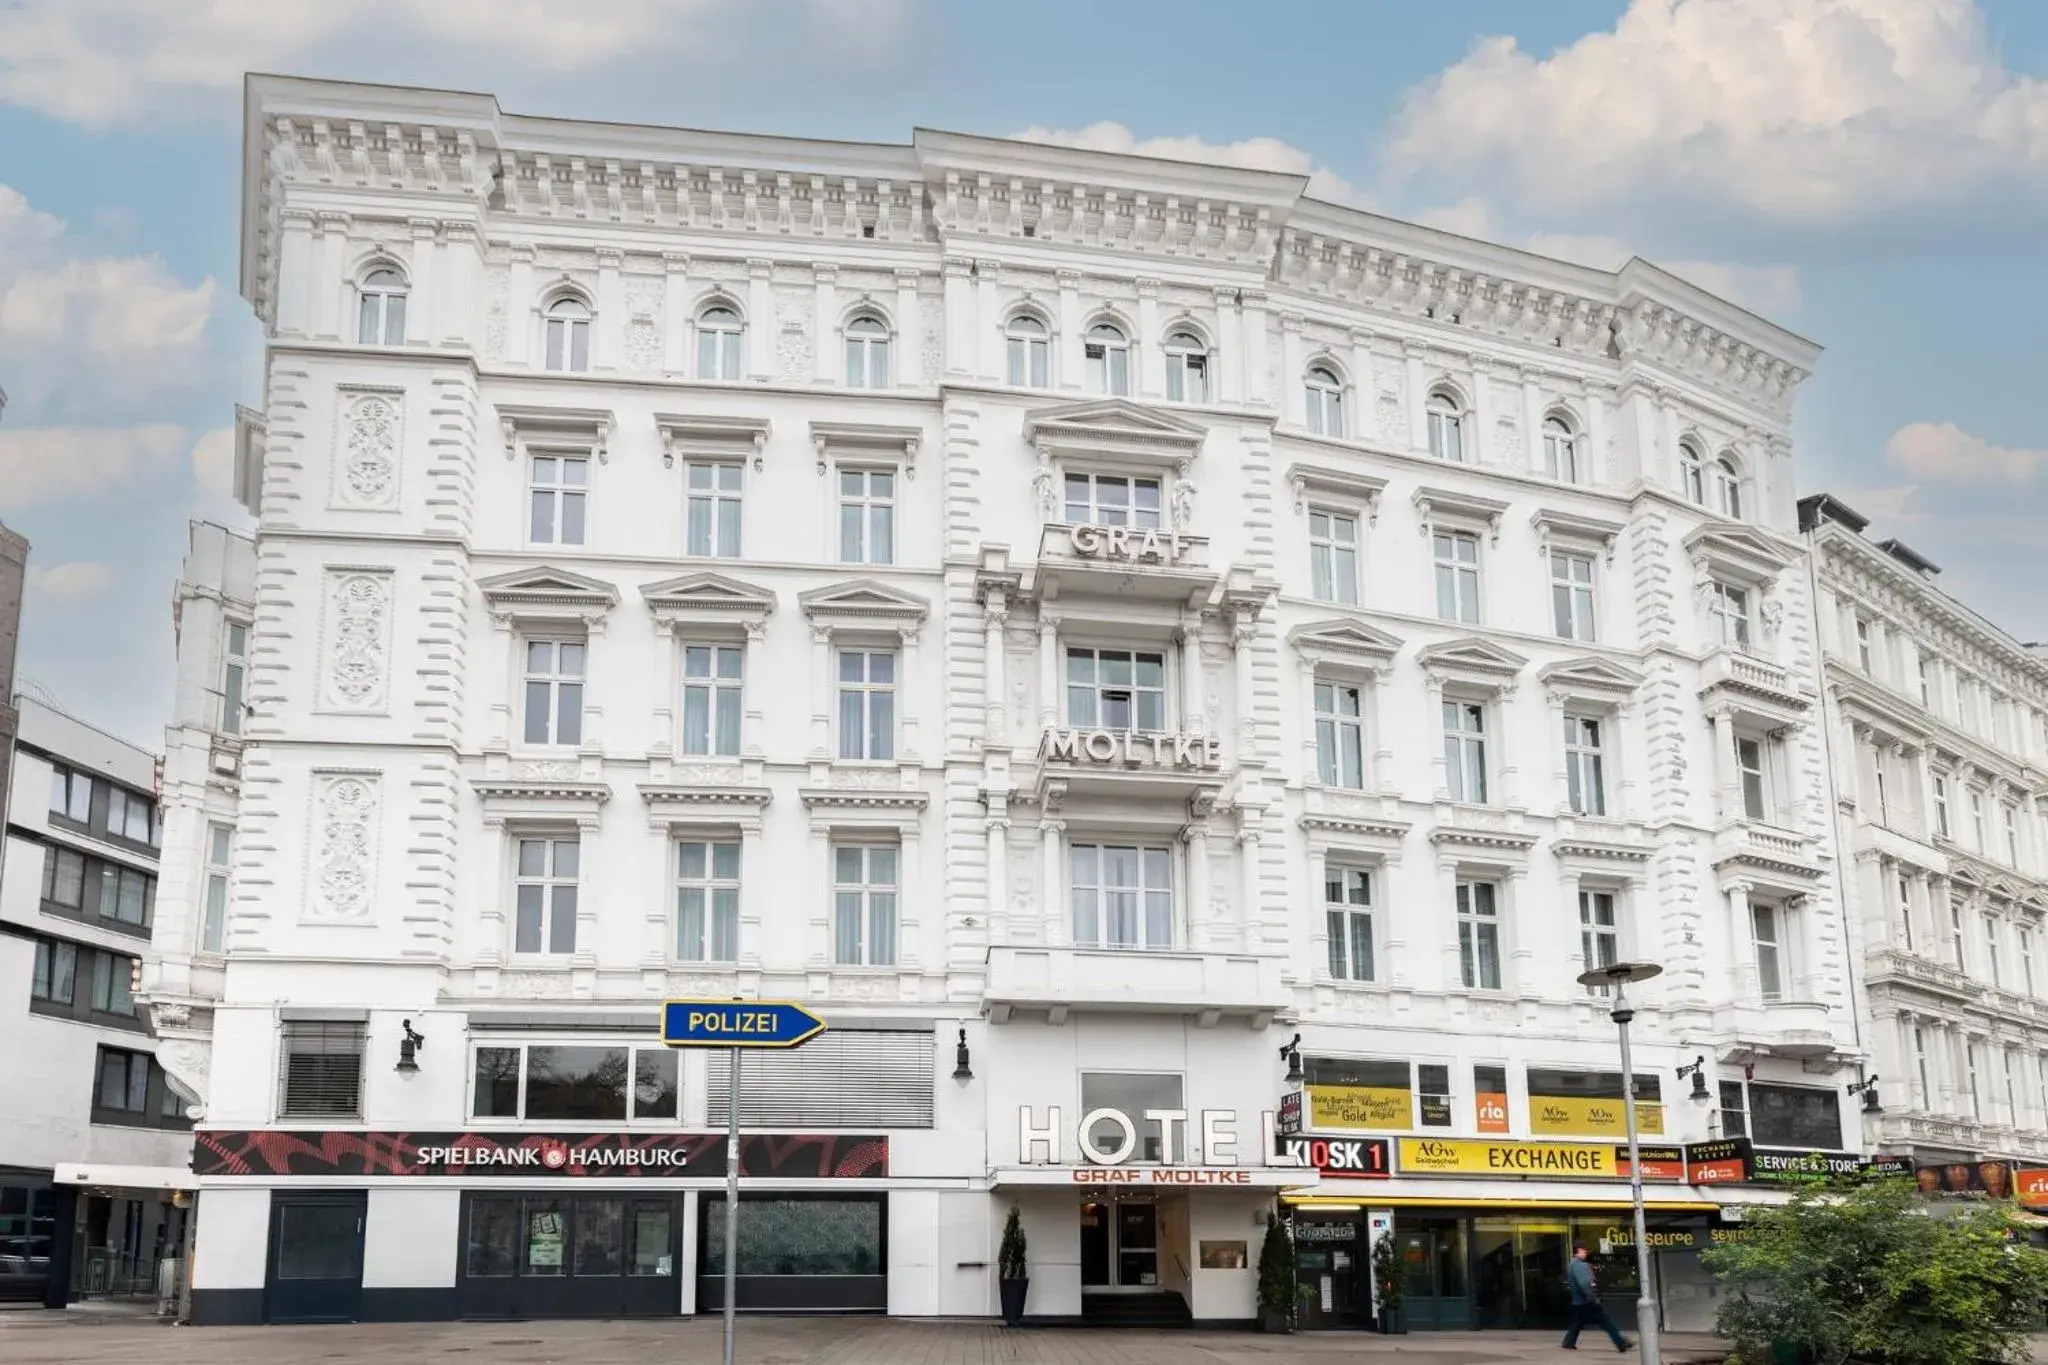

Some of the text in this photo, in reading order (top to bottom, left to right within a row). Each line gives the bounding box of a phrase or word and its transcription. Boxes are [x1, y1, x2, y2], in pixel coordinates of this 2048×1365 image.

[1071, 524, 1189, 565] GRAF
[1044, 726, 1221, 768] MOLTKE
[689, 1012, 778, 1034] POLIZEI
[1283, 1094, 1300, 1107] LATE
[1480, 1101, 1504, 1119] ria
[1341, 1110, 1366, 1122] Gold
[1019, 1105, 1298, 1167] HOTEL
[417, 1147, 687, 1166] SPIELBANK HAMBURG
[1286, 1140, 1380, 1169] KIOSK 1
[1489, 1148, 1602, 1170] EXCHANGE
[1754, 1155, 1808, 1171] SERVICE
[1821, 1159, 1860, 1173] STORE
[1073, 1169, 1252, 1184] GRAF MOLTKE
[1697, 1165, 1717, 1180] ria
